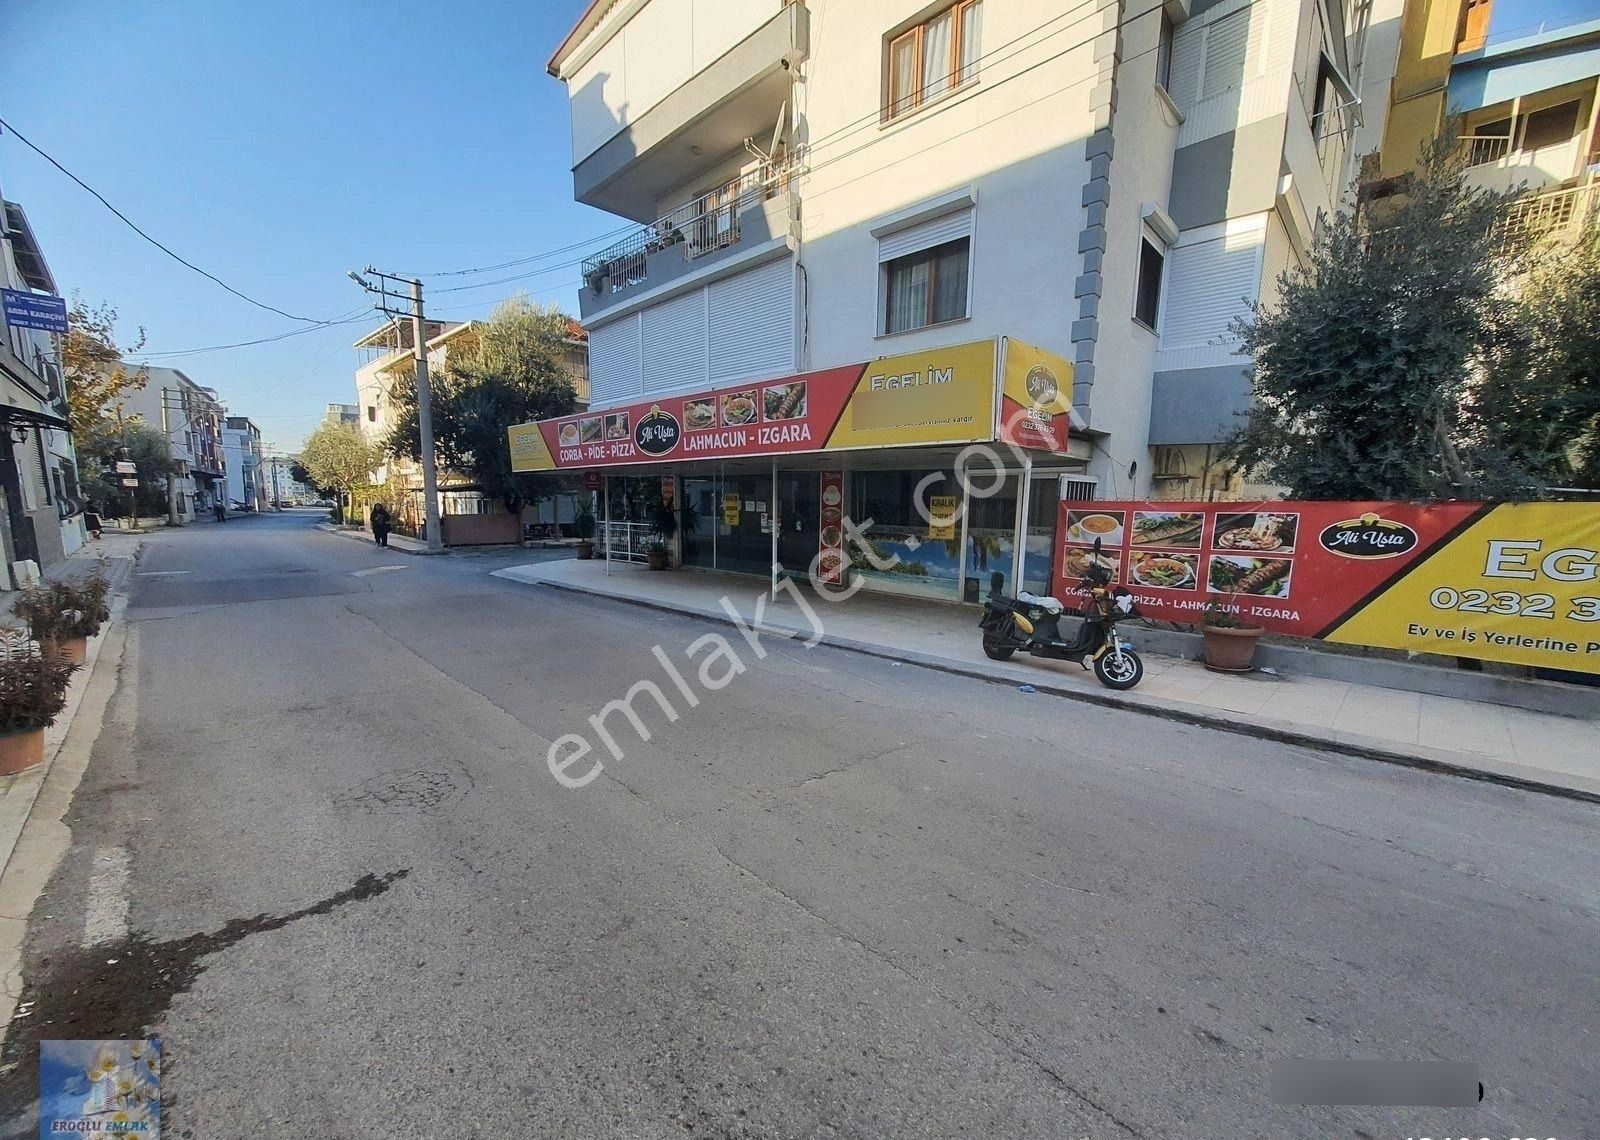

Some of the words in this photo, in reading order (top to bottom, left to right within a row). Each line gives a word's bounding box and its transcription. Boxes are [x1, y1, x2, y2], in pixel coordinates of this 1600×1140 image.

[640, 426, 653, 444] Ali
[653, 425, 675, 442] Usta
[683, 430, 746, 451] LAHMACUN
[758, 423, 811, 445] IZGARA
[560, 449, 583, 463] ÇORBA
[588, 445, 606, 460] PİDE
[611, 441, 636, 457] PİZZA
[1329, 530, 1359, 546] Ali
[1362, 531, 1405, 547] Usta
[1481, 539, 1600, 583] EG
[1133, 594, 1164, 607] PİZZA
[1251, 606, 1300, 621] IZGARA
[1430, 586, 1555, 619] 0232
[1408, 624, 1429, 636] Ev
[1434, 628, 1455, 639] ve
[1461, 626, 1476, 643] İş
[1484, 631, 1578, 652] Yerlerine
